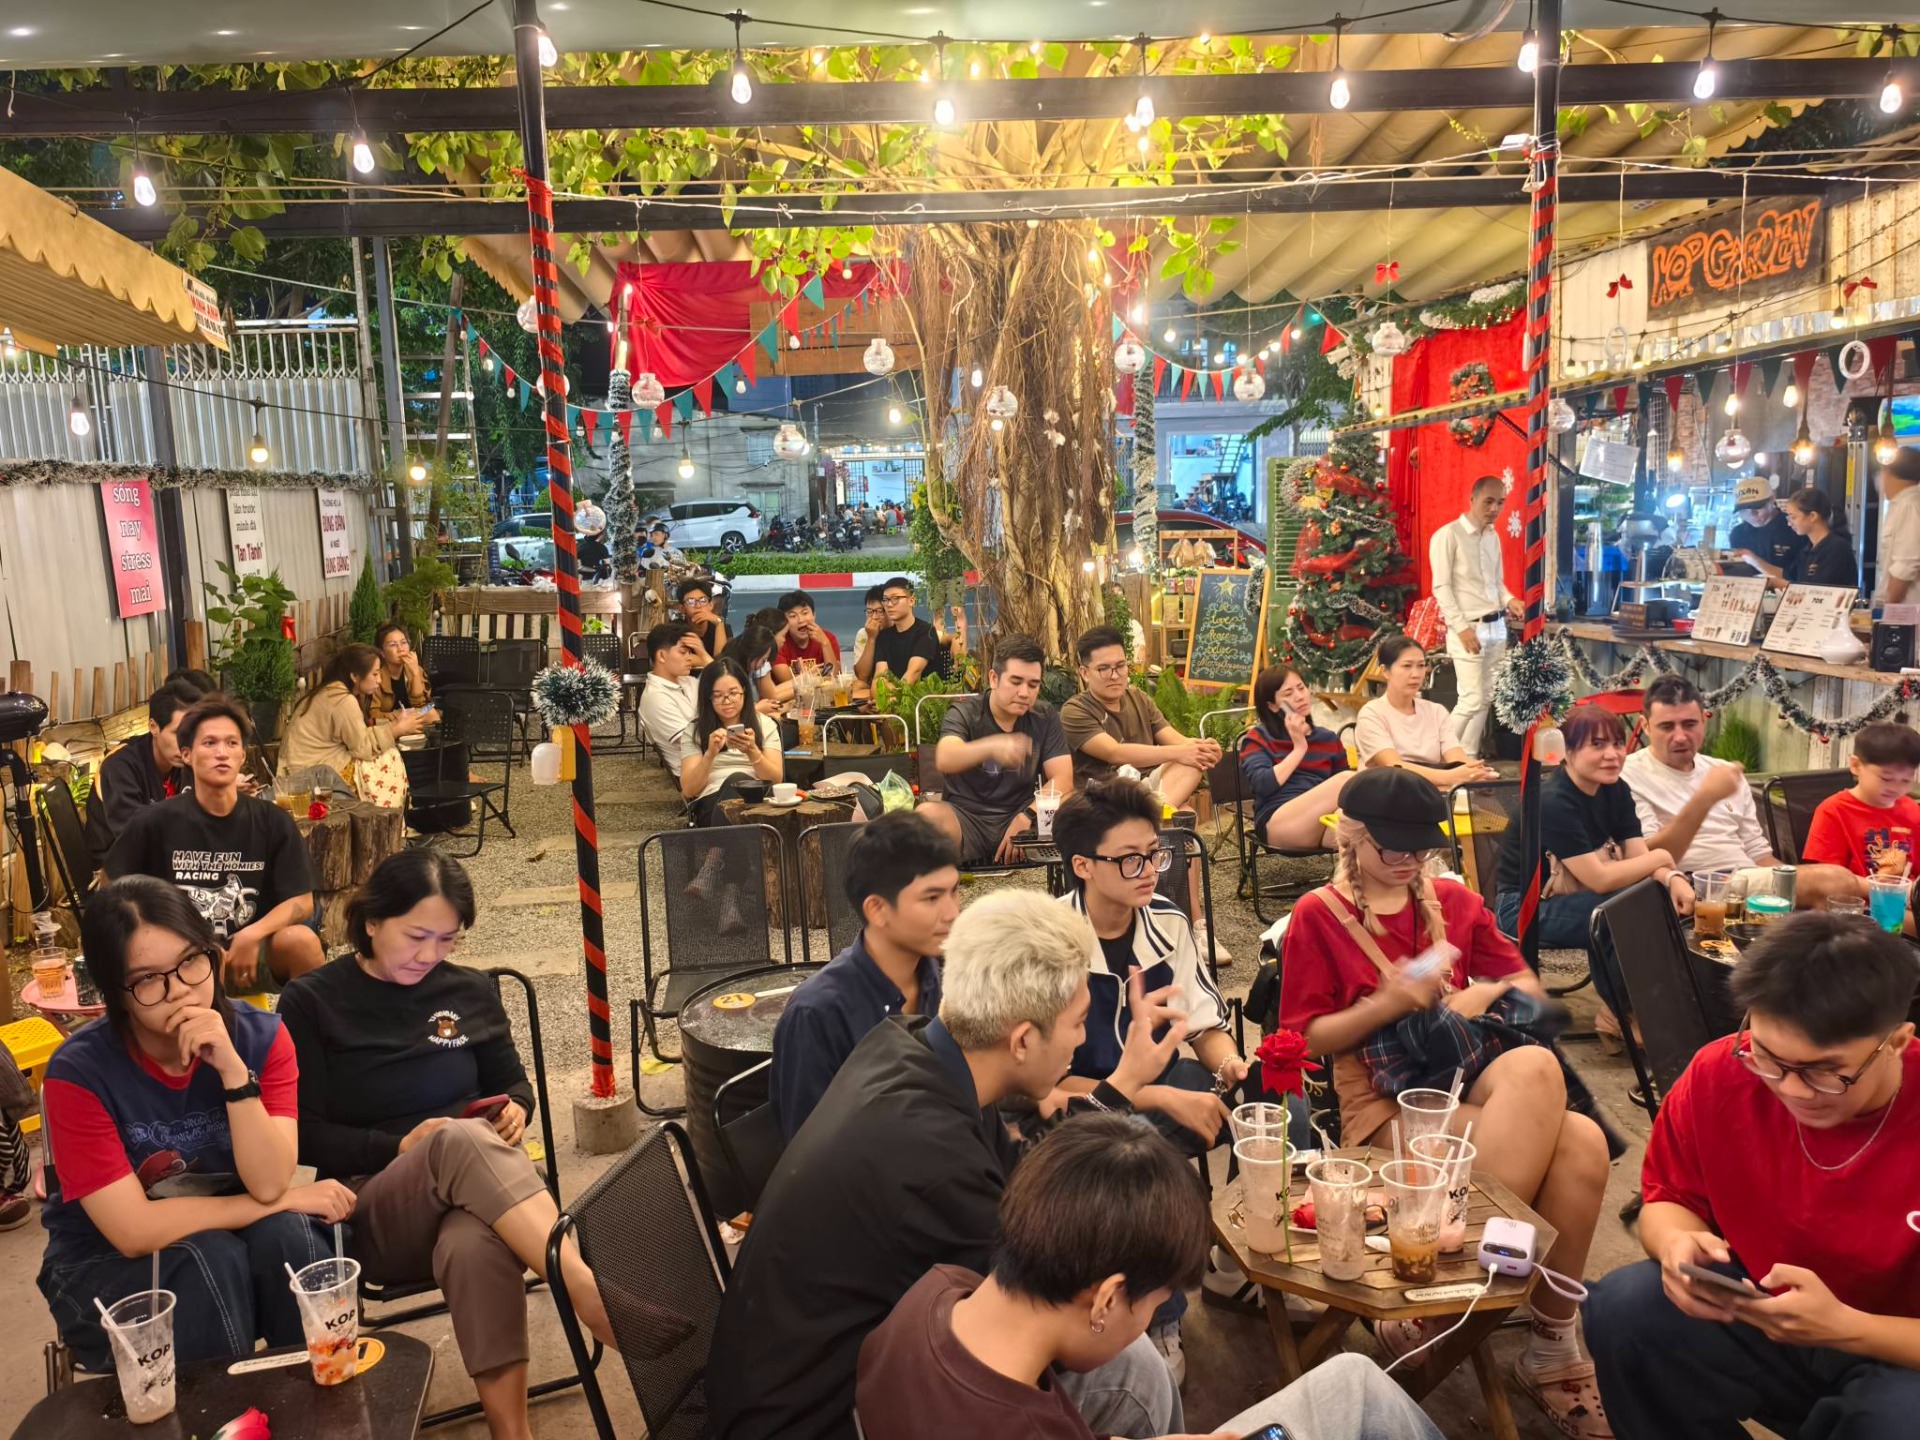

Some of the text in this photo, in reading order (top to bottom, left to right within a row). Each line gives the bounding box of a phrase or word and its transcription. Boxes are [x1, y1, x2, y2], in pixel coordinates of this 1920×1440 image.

[112, 481, 141, 507] sống
[120, 519, 142, 541] nay
[121, 551, 152, 571] stress
[130, 580, 152, 604] mai
[1212, 615, 1231, 624] Love
[172, 850, 241, 862] HAVE FUN
[172, 861, 265, 871] WITH THE HOMIES!
[175, 872, 219, 881] RACING
[721, 994, 743, 1004] 21
[325, 1309, 355, 1330] KOP
[137, 1343, 170, 1367] KOP
